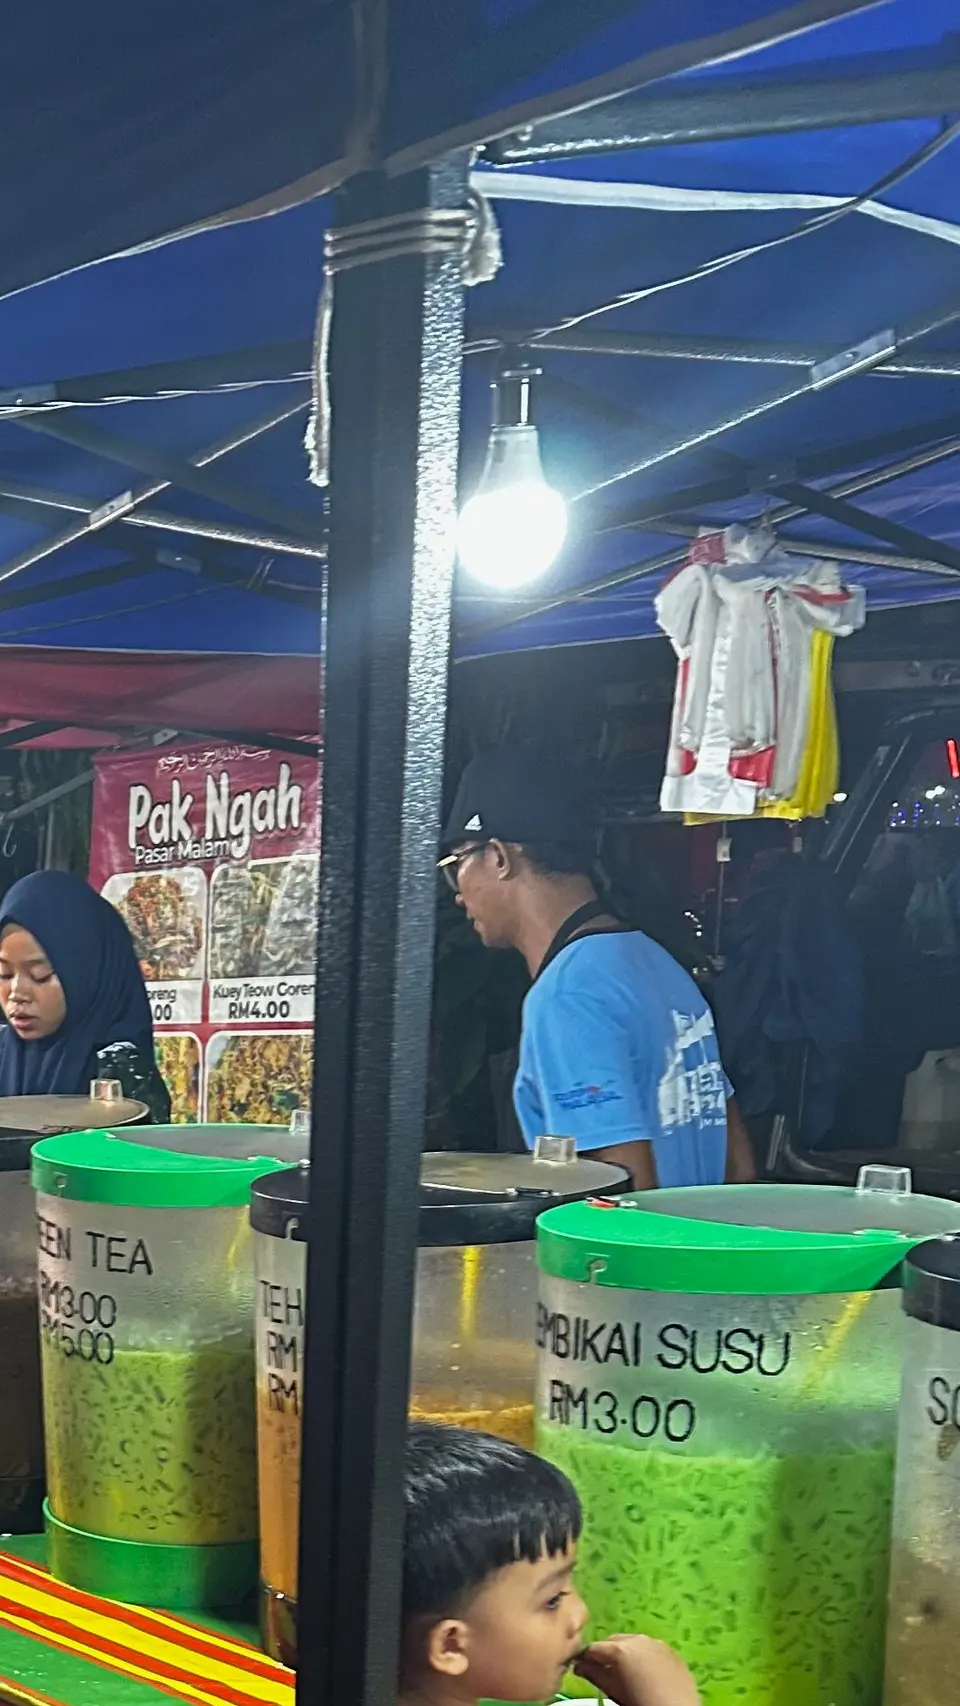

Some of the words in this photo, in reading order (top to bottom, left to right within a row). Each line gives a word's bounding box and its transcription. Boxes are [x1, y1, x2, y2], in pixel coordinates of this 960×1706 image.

[128, 778, 194, 849] Pak
[205, 763, 303, 859] Ngah
[135, 845, 175, 865] Pasar
[177, 838, 230, 861] Malam
[213, 984, 240, 1001] Kuey
[242, 983, 274, 998] Teow
[228, 1000, 290, 1020] RM4.00
[85, 1230, 155, 1277] TEA
[259, 1278, 305, 1327] TEH
[266, 1329, 298, 1373] RM
[656, 1322, 792, 1377] SUSU
[268, 1372, 300, 1416] RM
[549, 1378, 697, 1443] RM3.00
